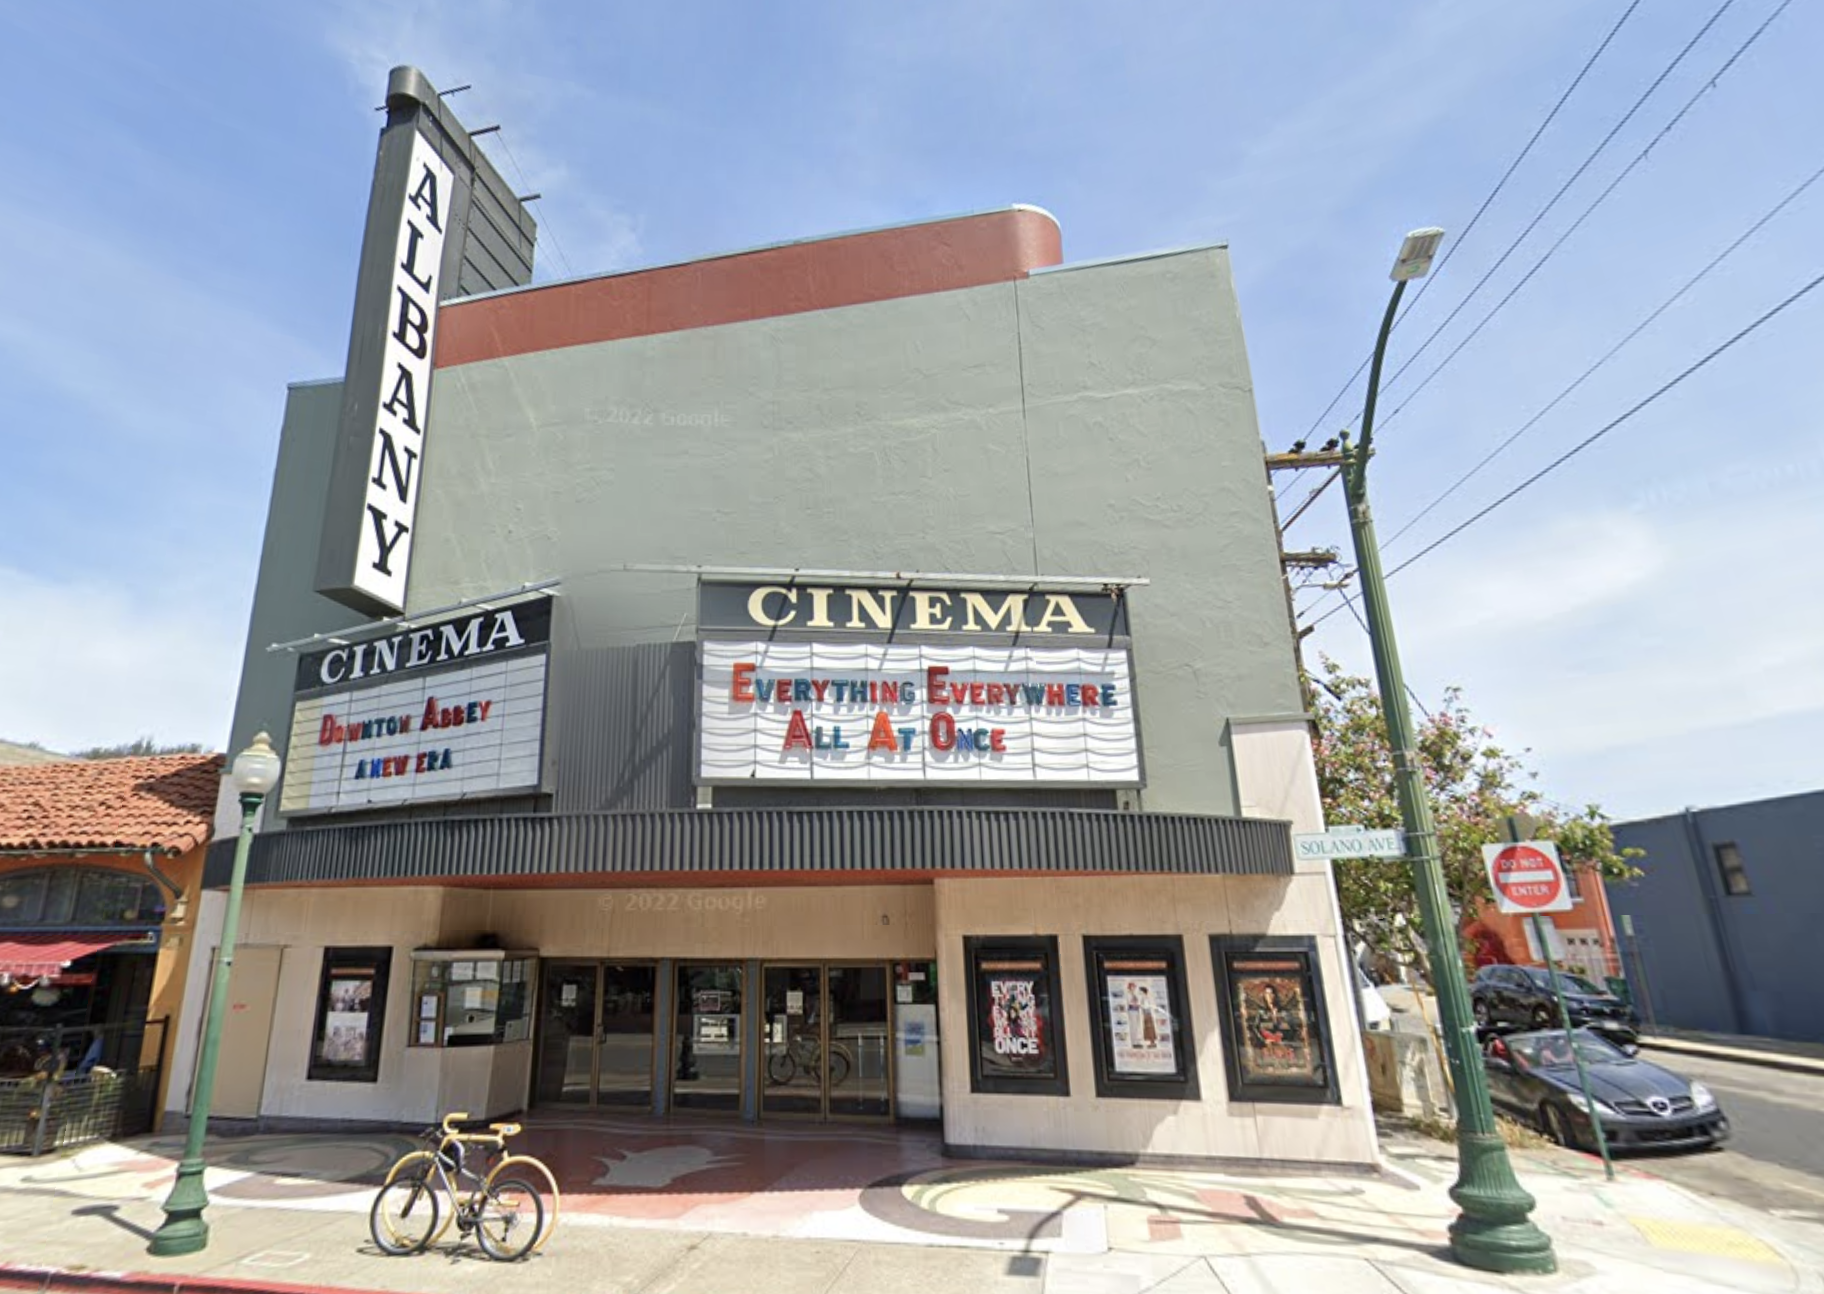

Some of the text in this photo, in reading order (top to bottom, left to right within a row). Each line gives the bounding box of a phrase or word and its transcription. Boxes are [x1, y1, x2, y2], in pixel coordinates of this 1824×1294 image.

[366, 162, 443, 577] ALBANY
[747, 585, 1096, 634] CINEMA
[320, 610, 525, 684] CINEMA
[731, 662, 1119, 707] EVERYTHING EVERYWHERE
[318, 696, 492, 747] DOWNTON ABBEY
[782, 709, 1008, 753] ALL AT ONCE
[415, 748, 453, 774] ERA
[1300, 840, 1363, 855] SOLANO
[1501, 857, 1544, 870] DO NOT
[1511, 885, 1551, 896] ENTER
[991, 981, 1034, 996] EVERY
[994, 1037, 1040, 1054] ONCE
